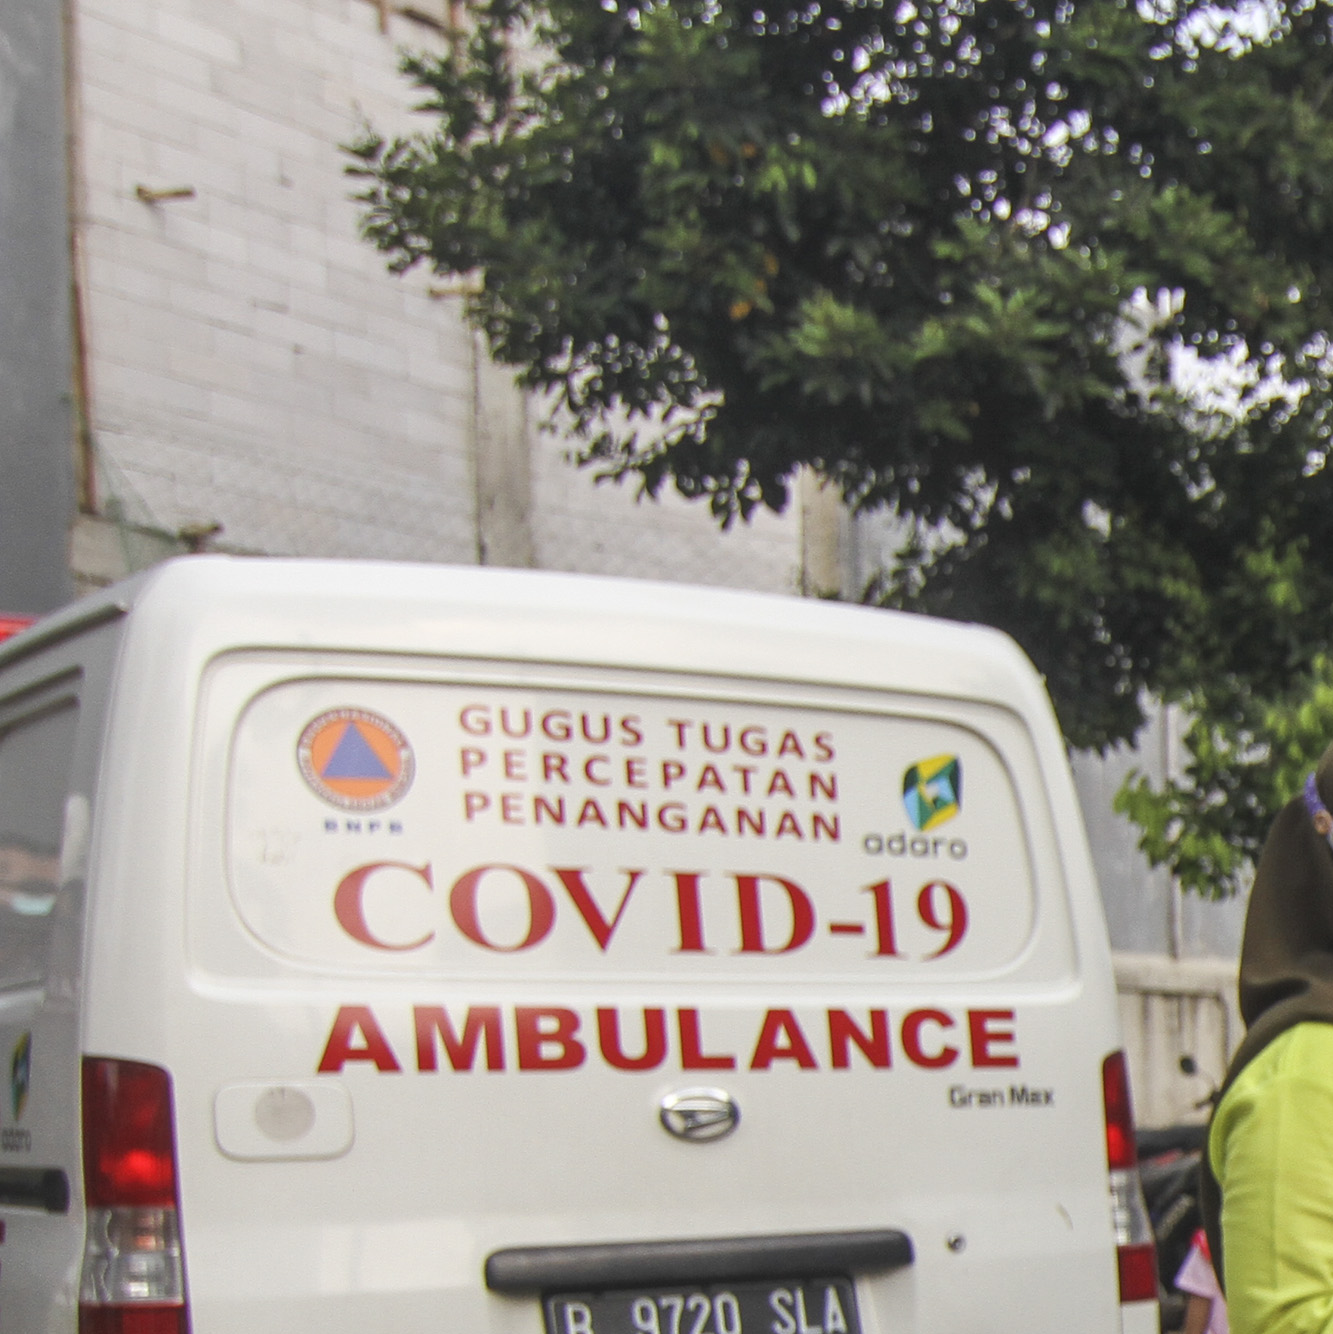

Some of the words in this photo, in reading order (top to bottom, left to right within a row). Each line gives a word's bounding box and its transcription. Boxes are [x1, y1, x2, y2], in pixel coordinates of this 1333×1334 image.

[460, 705, 643, 748] GUGUS
[667, 719, 836, 762] TUGAS
[461, 748, 839, 801] PERCEPATAN
[464, 793, 842, 842] PENANGANAN
[863, 831, 968, 860] adaro
[333, 860, 969, 961] COVID-19
[316, 1003, 1021, 1074] AMBULANCE
[948, 1085, 1005, 1108] Gran
[1008, 1084, 1054, 1106] Max
